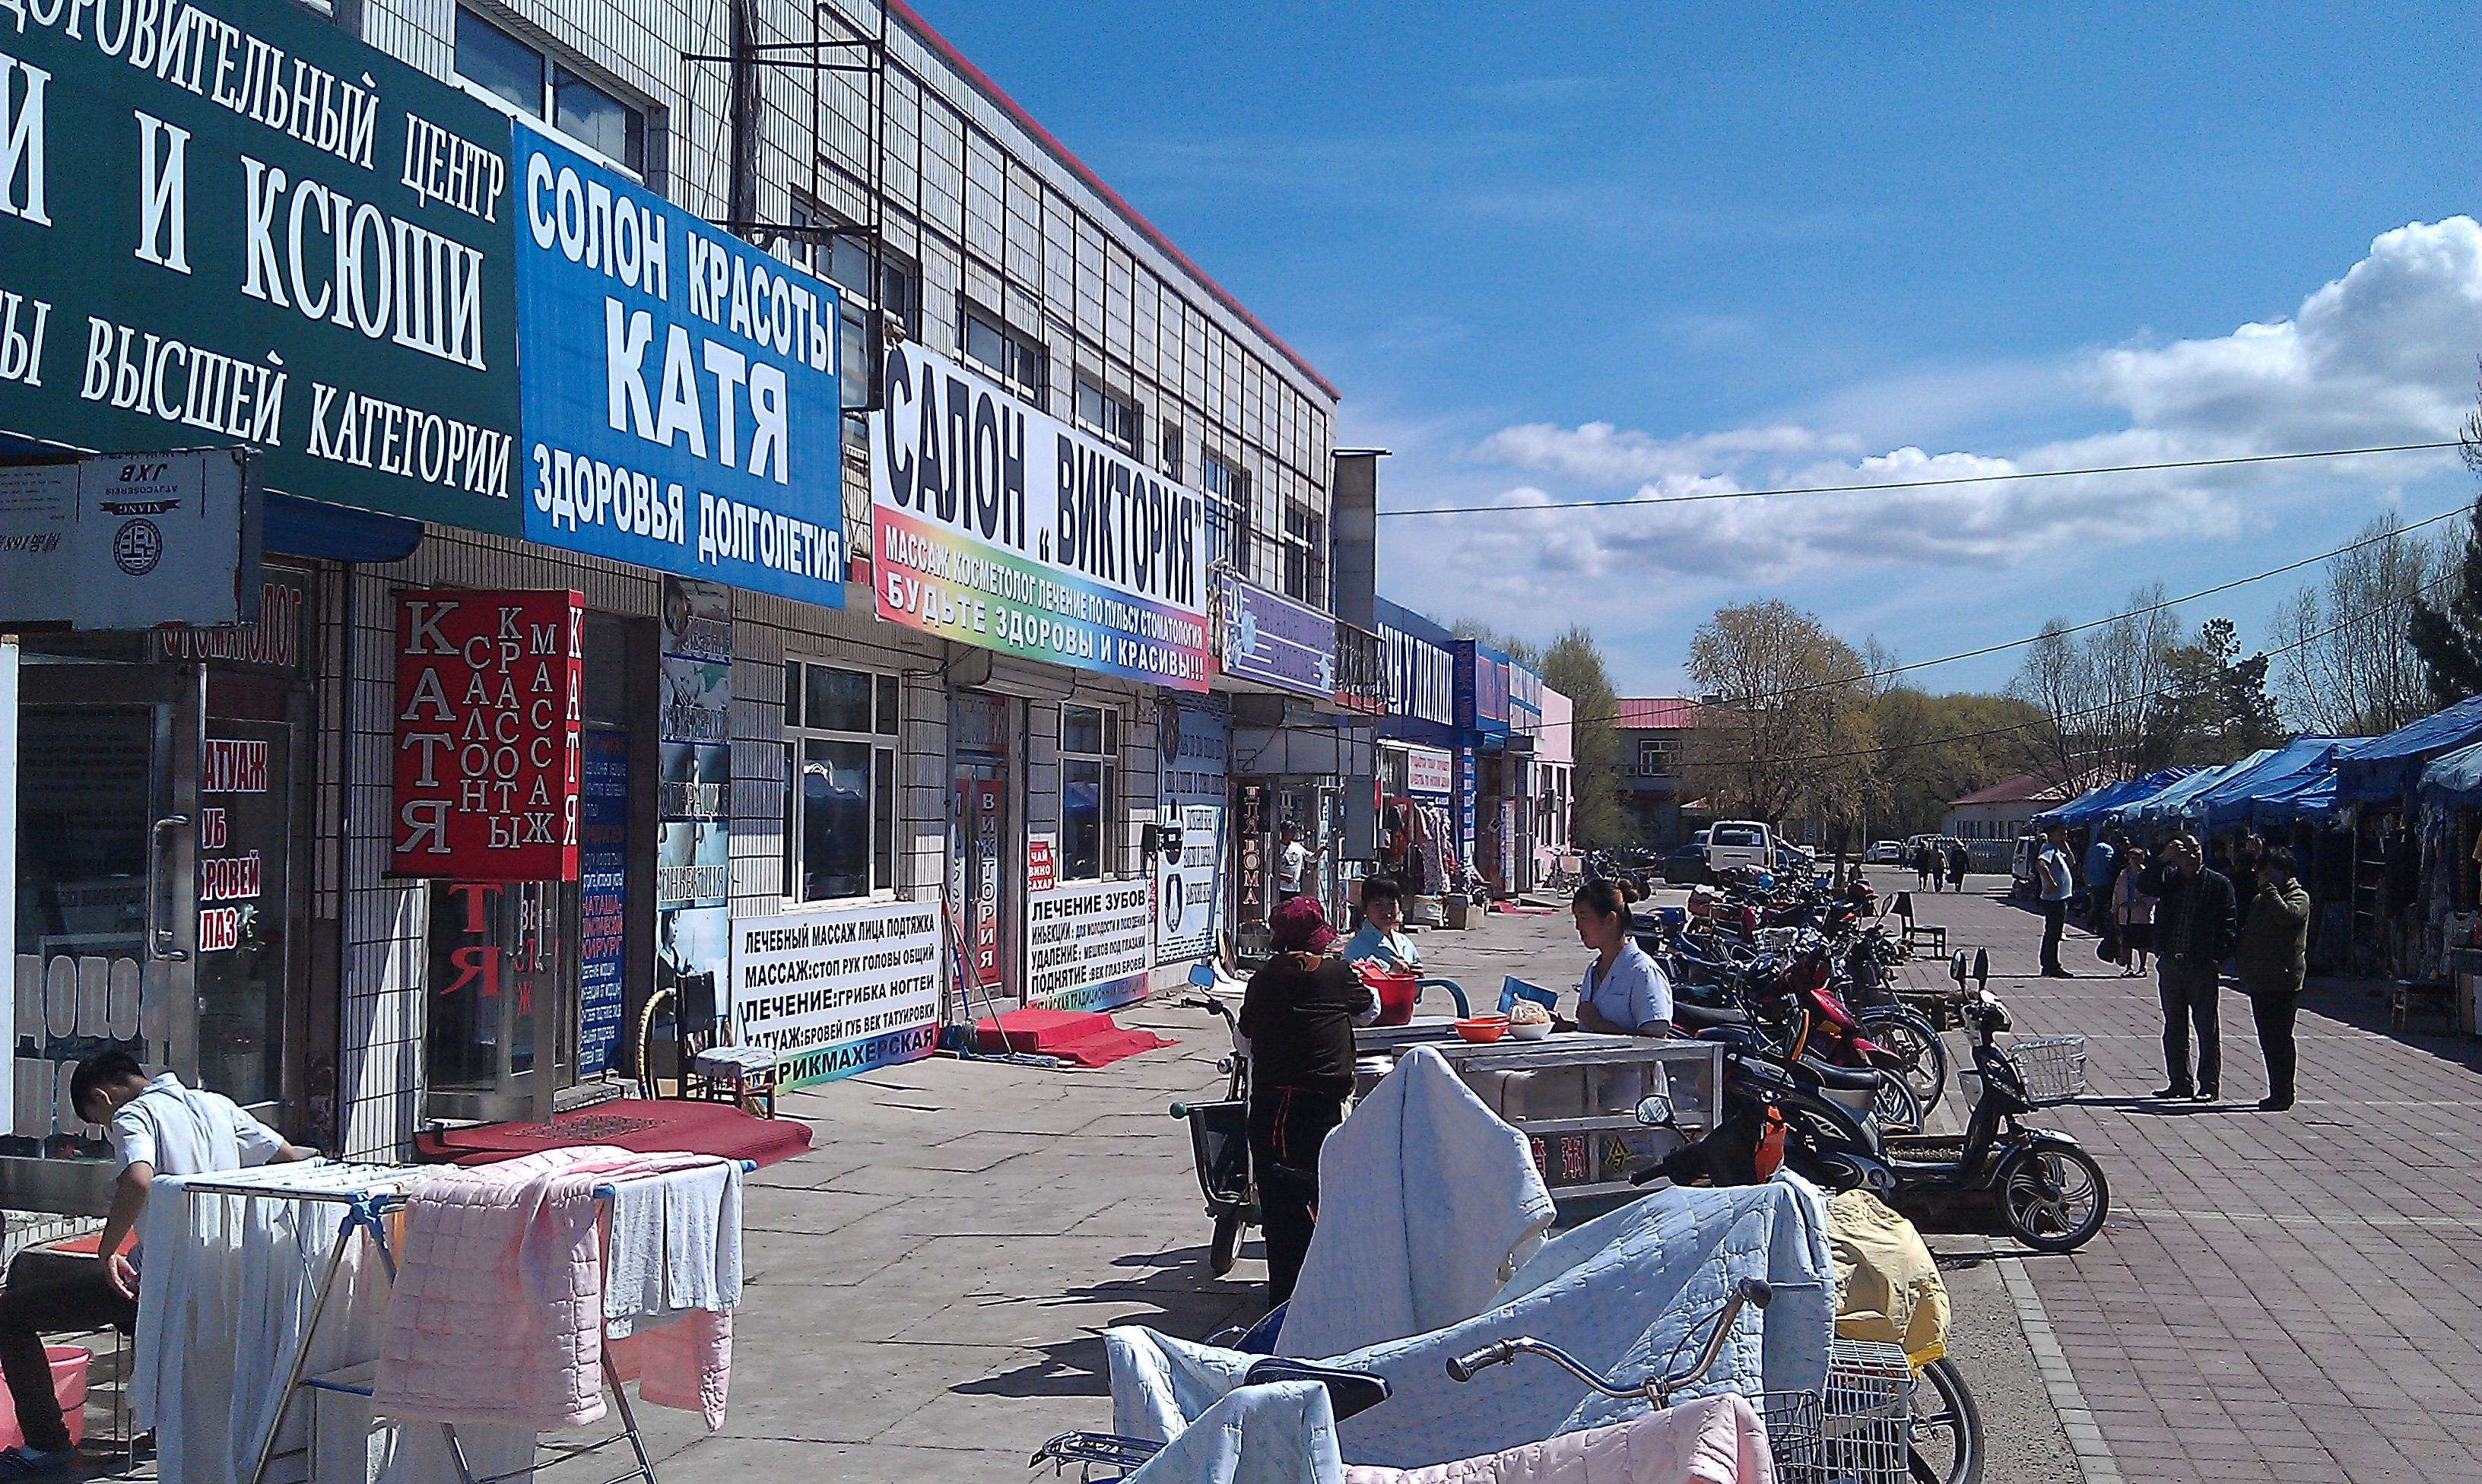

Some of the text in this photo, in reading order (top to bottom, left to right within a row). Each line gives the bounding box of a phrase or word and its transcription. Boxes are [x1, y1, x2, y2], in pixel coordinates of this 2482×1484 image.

[0, 0, 506, 224] ОВИТЕЛЬНЫЙ ЦЕНТР
[134, 109, 192, 274] И
[240, 154, 487, 372] КСЮШИ
[525, 151, 835, 376] СОЛОН КРАСОТЫ
[0, 289, 513, 499] Ы ВЫСШЕЙ КАТЕГОРИИ
[605, 294, 789, 486] КАТЯ
[884, 347, 1026, 552] САЛОН
[117, 503, 162, 515] XIANG
[533, 442, 840, 585] ЗДОРОВЬЯ ДОЛГОЛЕТИЯ
[885, 524, 1203, 650] МАССАЖ КОСМЕТОЛОГ ЛЕЧЕНИЕ ПО ПУЛЬСУ СТОМАТОЛОГИЯ
[887, 571, 1204, 682] БУДЬТЕ ЗДОРОВЫ И КРАСИВЫ!!!
[395, 600, 461, 854] КАТЯ
[459, 635, 491, 813] САЛОН
[487, 607, 523, 849] КРАСОТЫ
[522, 623, 557, 844] МАССАЖ
[562, 607, 583, 846] КАТЯ
[660, 781, 729, 820] ОПЕРАЦИЯ
[1030, 848, 1048, 862] ЧАЙ
[744, 913, 935, 954] ЛЕЧЕБНЫЙ МАССАЖ ЛИЦА ПОДТЯЖКА
[979, 792, 995, 969] ВИКТОРИЯ
[1027, 878, 1052, 891] САХАР
[1029, 864, 1051, 877] ВИНО
[1031, 895, 1102, 921] ЛЕЧЕНИЕ
[1106, 889, 1145, 914] ЗУБОВ
[1243, 839, 1260, 905] ДОМА
[843, 956, 861, 975] РУК
[862, 951, 901, 971] ГОЛОВЫ
[903, 943, 935, 965] ОБЩИЙ
[845, 1019, 862, 1037] ГУБ
[864, 1013, 881, 1032] ВЕК
[883, 1003, 935, 1029] ТАТУИРОВКИ
[1031, 965, 1087, 996] ПОДНЯТИЕ
[1105, 962, 1121, 978] ГЛАЗ
[1604, 1133, 1631, 1174] 冷
